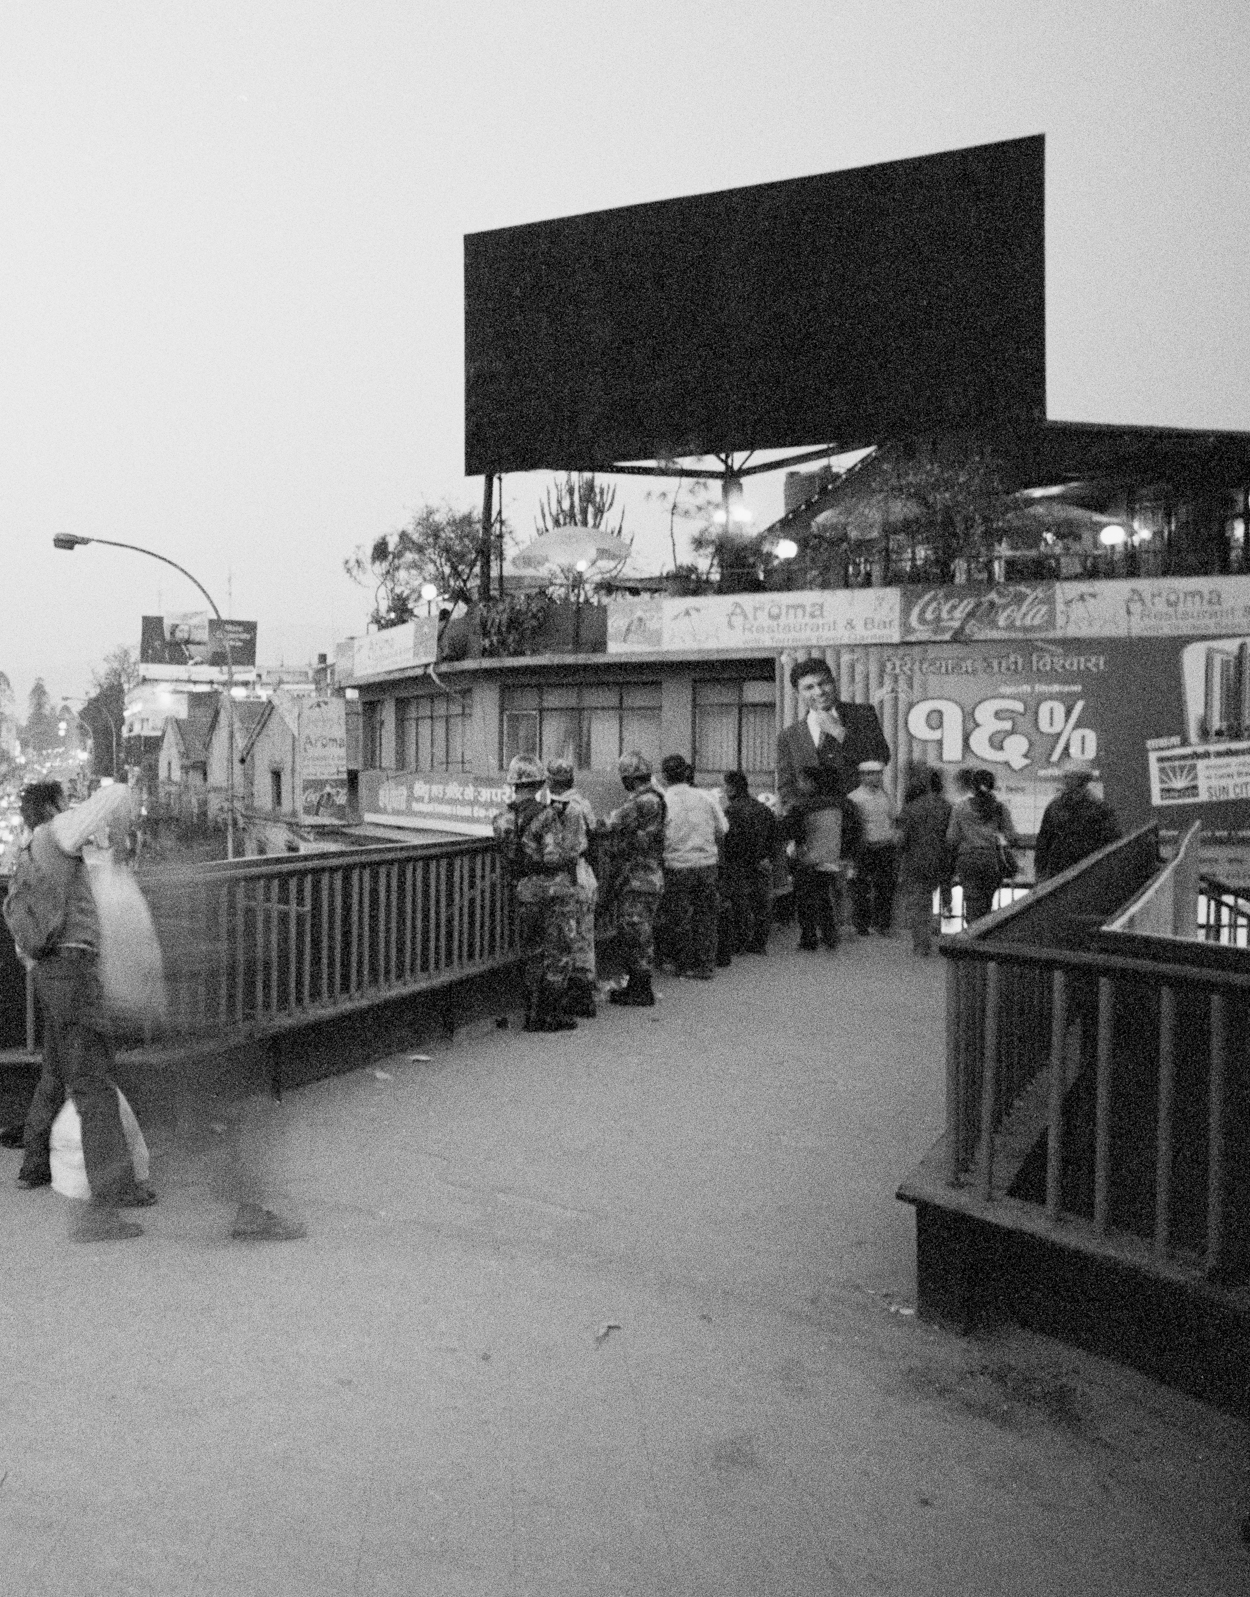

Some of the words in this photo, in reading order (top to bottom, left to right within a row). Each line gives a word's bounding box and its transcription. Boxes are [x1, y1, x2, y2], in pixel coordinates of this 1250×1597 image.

[726, 601, 826, 630] Aroma
[909, 585, 1050, 630] Cocaola
[1125, 588, 1223, 616] Aroma
[742, 618, 837, 635] Restaurant
[844, 617, 856, 632] &
[863, 616, 895, 631] Bar
[1207, 784, 1230, 800] SUN
